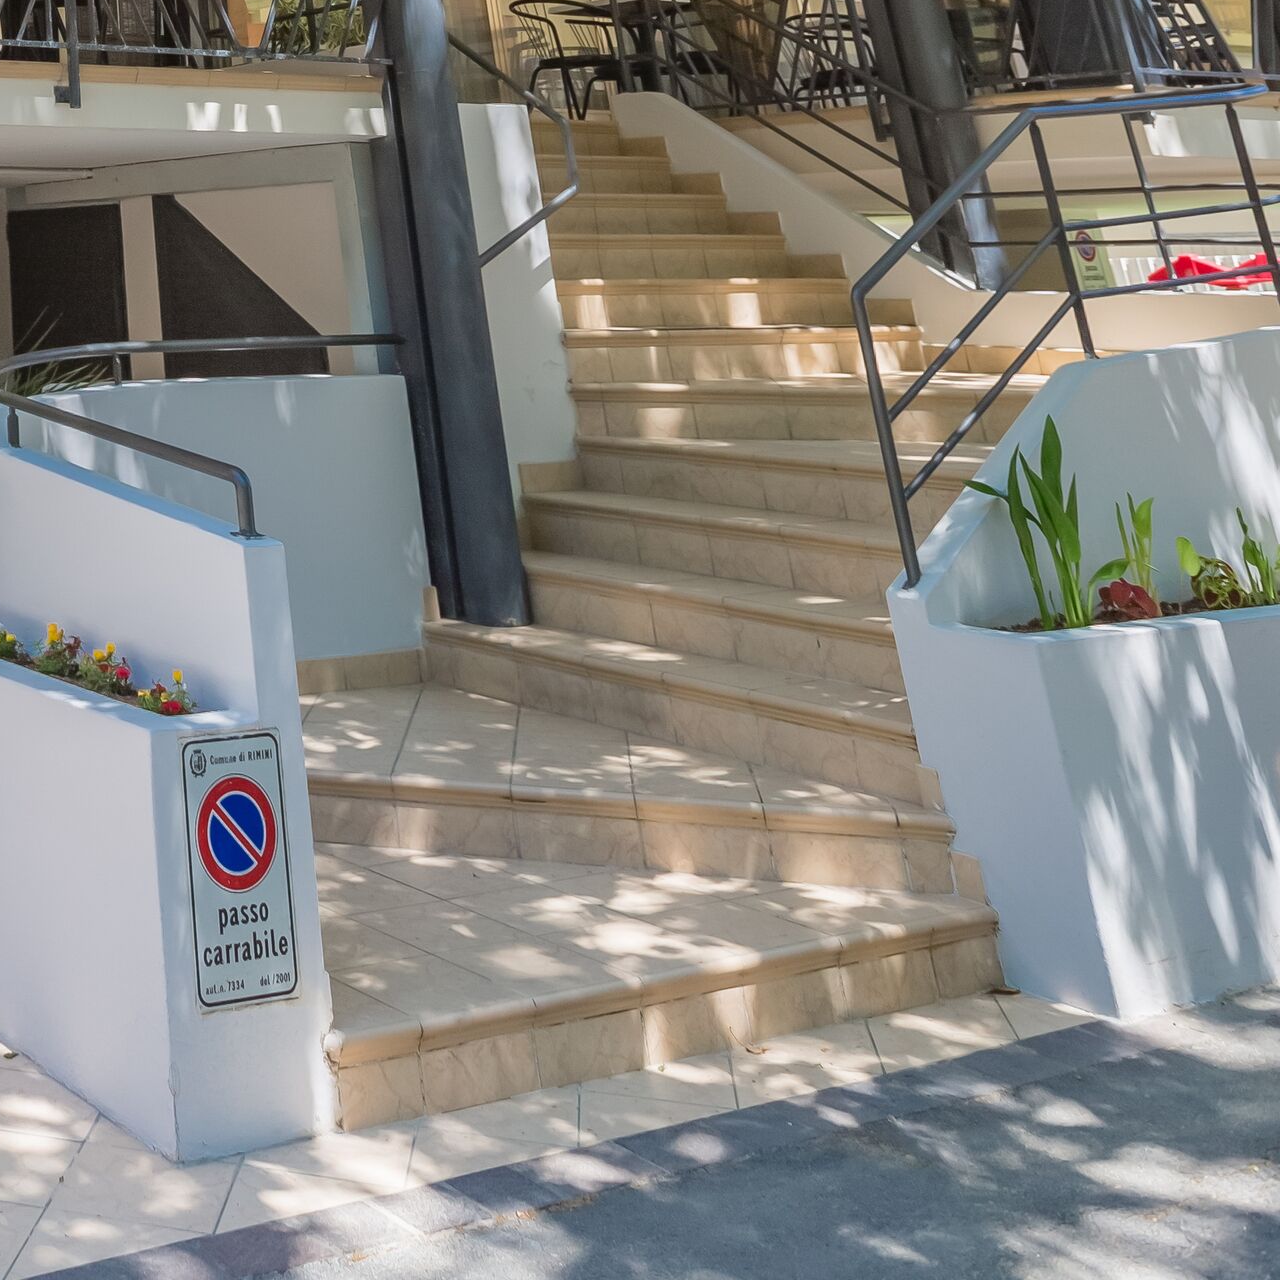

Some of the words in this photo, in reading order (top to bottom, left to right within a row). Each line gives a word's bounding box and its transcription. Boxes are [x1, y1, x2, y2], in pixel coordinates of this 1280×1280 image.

[209, 754, 237, 765] Comune
[239, 751, 246, 762] di
[247, 748, 273, 761] RIMINI
[218, 902, 269, 935] passo
[203, 928, 289, 967] carrabile
